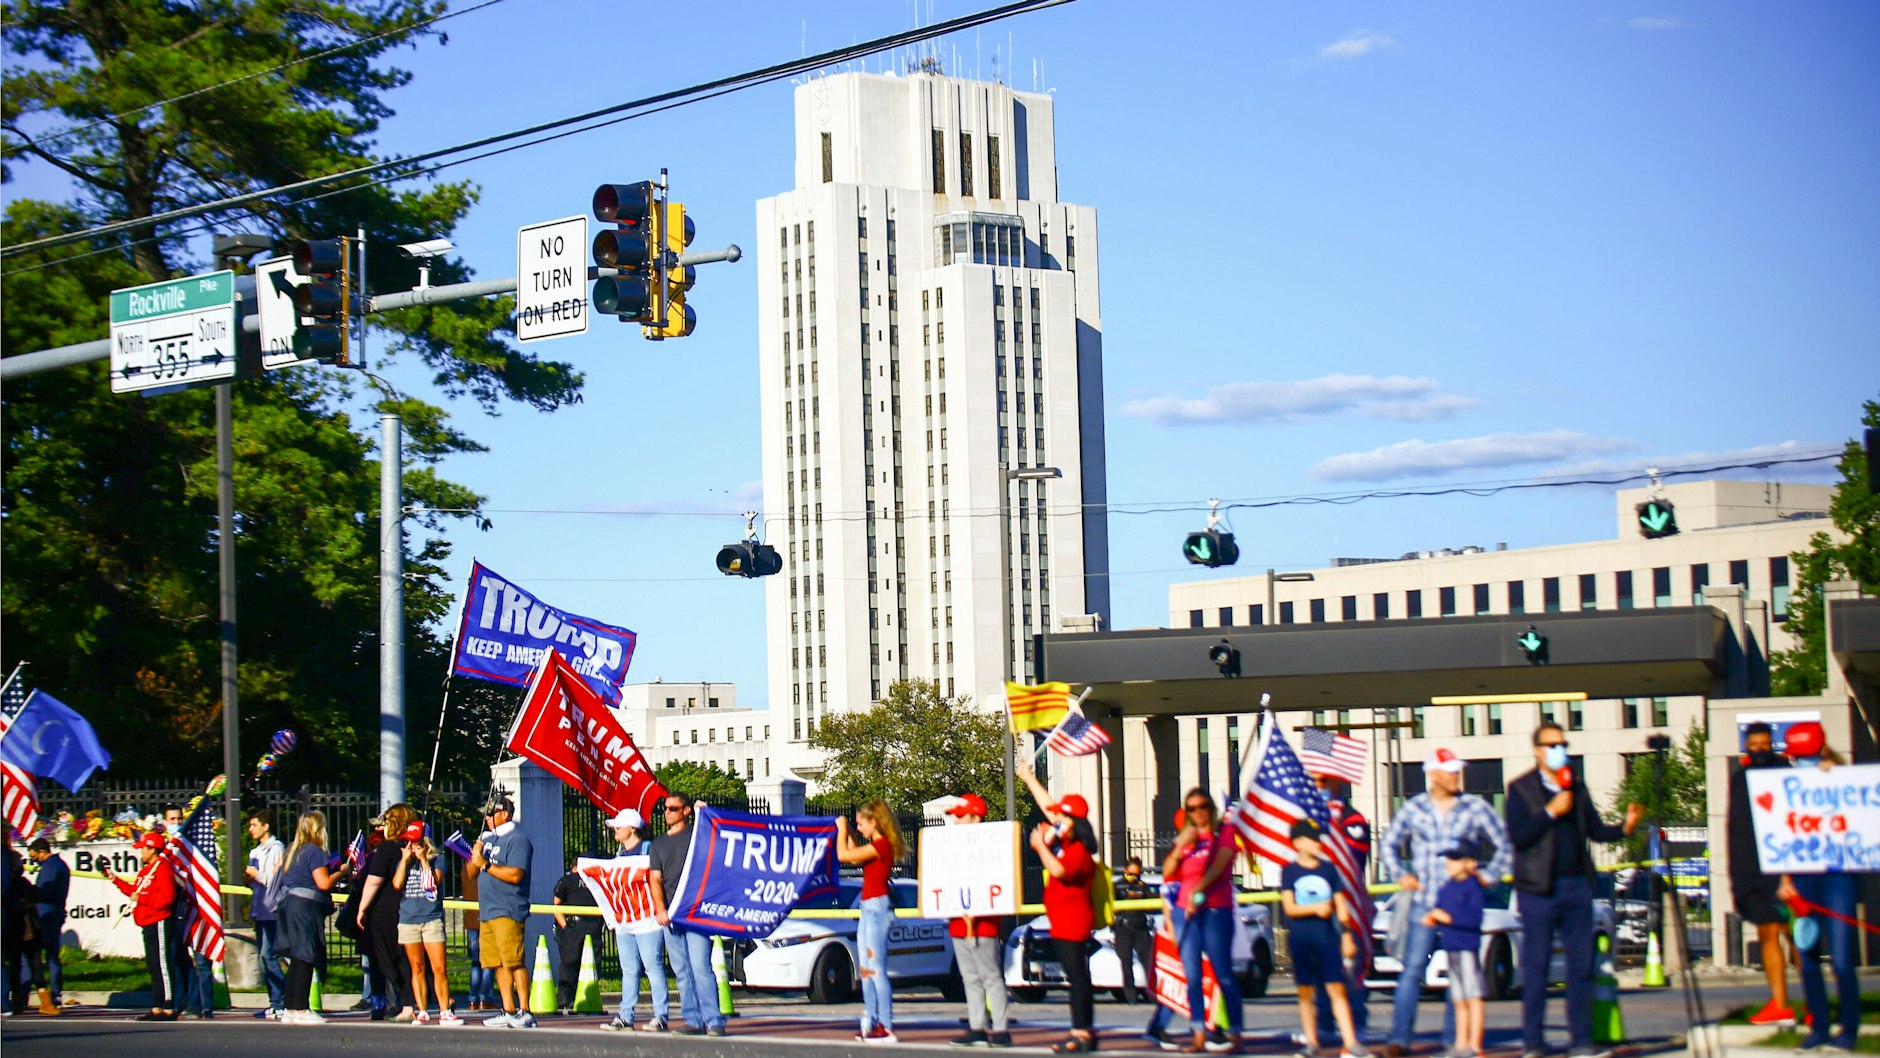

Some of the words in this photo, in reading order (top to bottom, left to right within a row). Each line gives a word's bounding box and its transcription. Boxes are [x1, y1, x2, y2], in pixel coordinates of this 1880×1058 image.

[540, 236, 564, 259] NO
[533, 266, 572, 292] TURN
[129, 288, 187, 317] Rockville
[199, 278, 218, 293] Pike
[524, 304, 544, 326] ON
[552, 298, 581, 322] RED
[153, 340, 189, 380] 355
[270, 336, 291, 356] ON
[479, 575, 623, 671] TRUMP
[466, 636, 502, 660] KEEP
[506, 644, 567, 668] AMER
[558, 716, 633, 787] PENCE
[1783, 775, 1880, 814] Prayers
[1786, 811, 1822, 834] for
[1830, 814, 1846, 833] a
[720, 829, 828, 875] TRUMP
[700, 901, 734, 919] KEEP
[888, 924, 944, 943] OLICE
